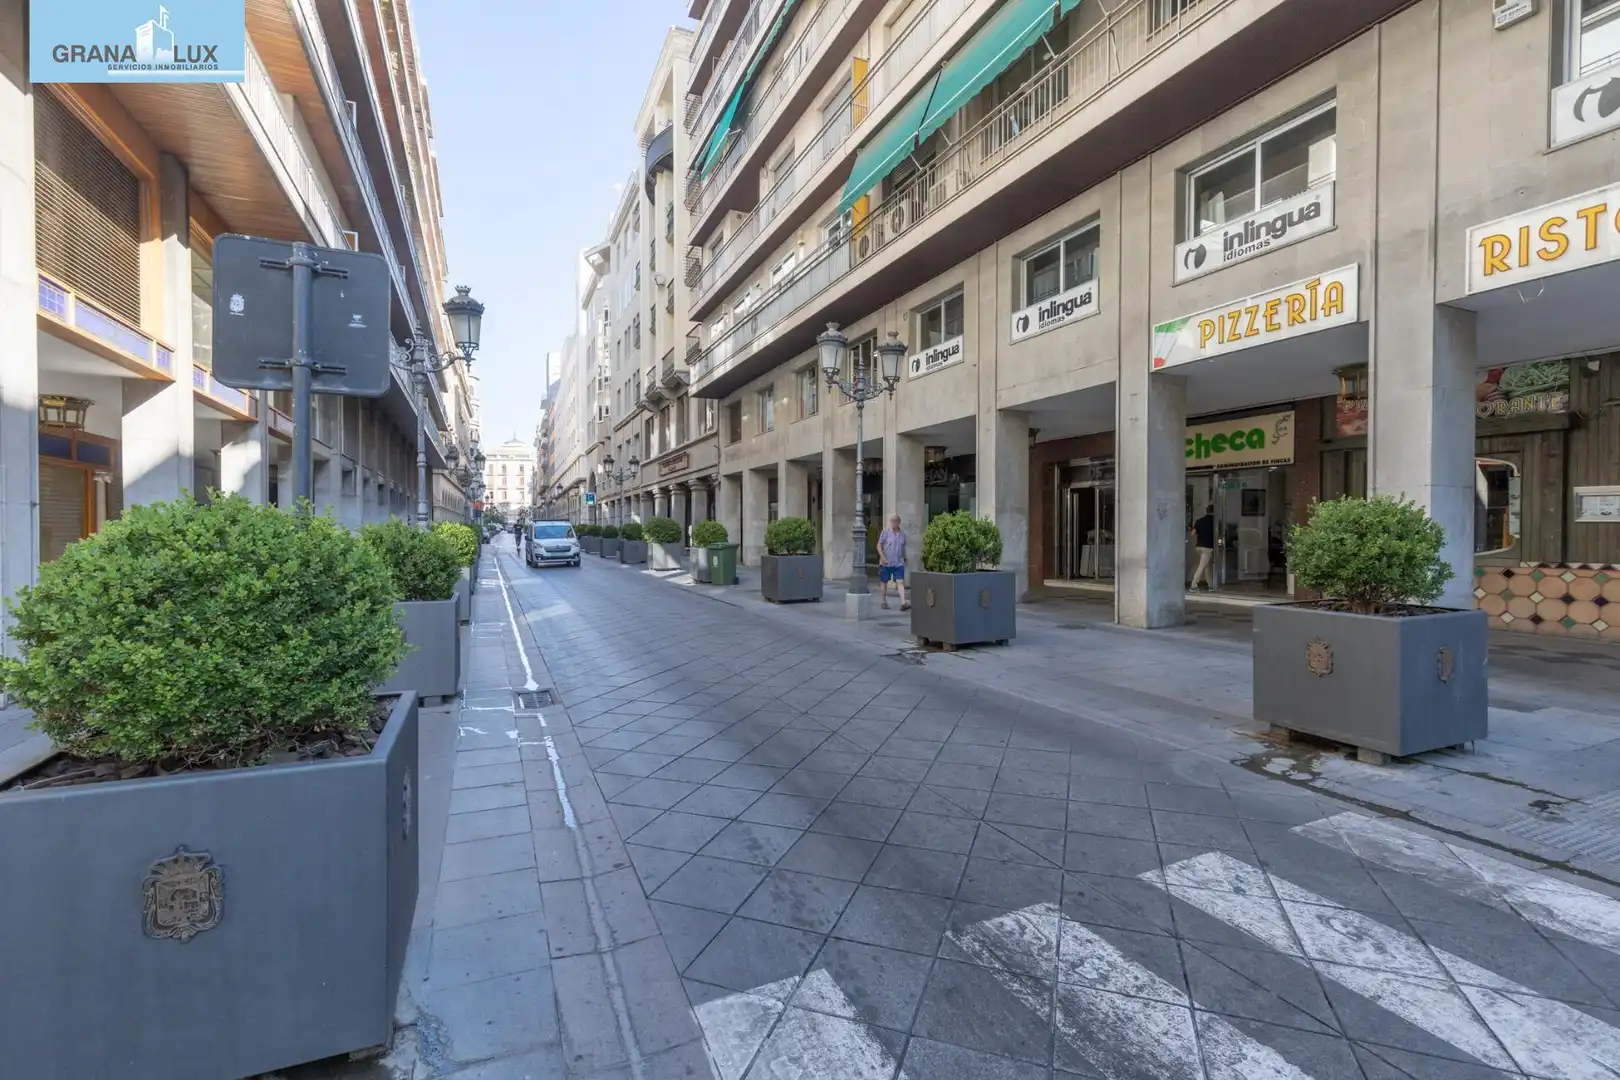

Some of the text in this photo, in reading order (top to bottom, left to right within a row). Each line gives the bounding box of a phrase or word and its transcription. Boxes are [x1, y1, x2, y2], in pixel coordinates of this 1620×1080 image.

[1223, 200, 1321, 253] inlingua
[1478, 202, 1620, 277] RIST
[1223, 238, 1271, 262] idiomas
[1038, 291, 1092, 323] inlingua
[1038, 315, 1066, 330] idiomas
[925, 344, 960, 366] inlingua
